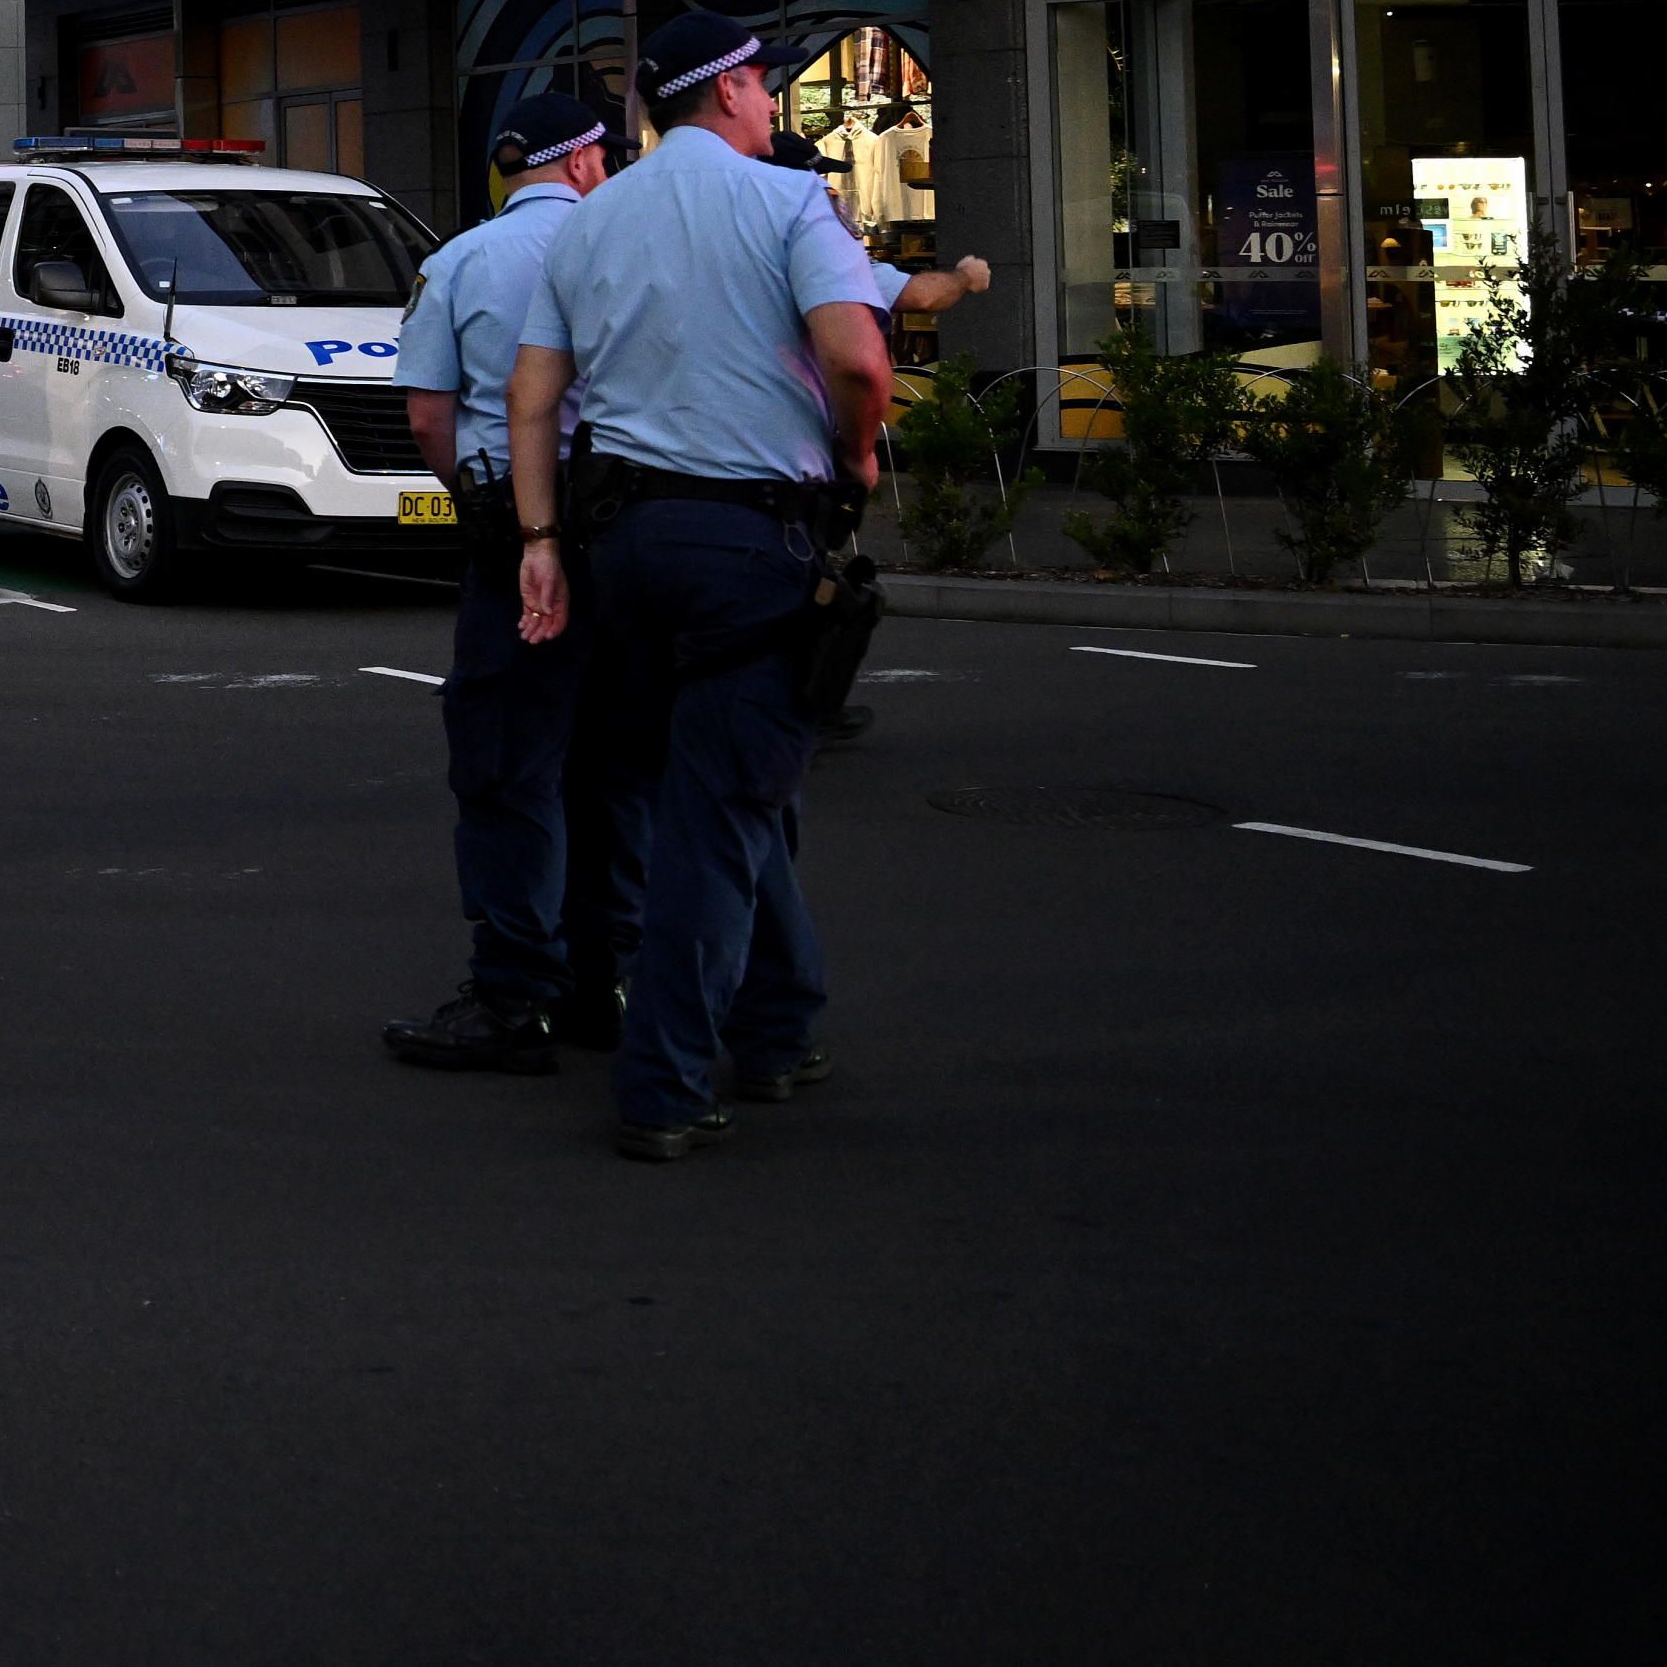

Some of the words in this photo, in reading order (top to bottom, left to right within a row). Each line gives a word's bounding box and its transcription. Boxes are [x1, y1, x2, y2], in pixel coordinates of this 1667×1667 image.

[1256, 184, 1294, 198] Sale
[1238, 231, 1317, 263] 40%
[57, 357, 80, 375] EB18
